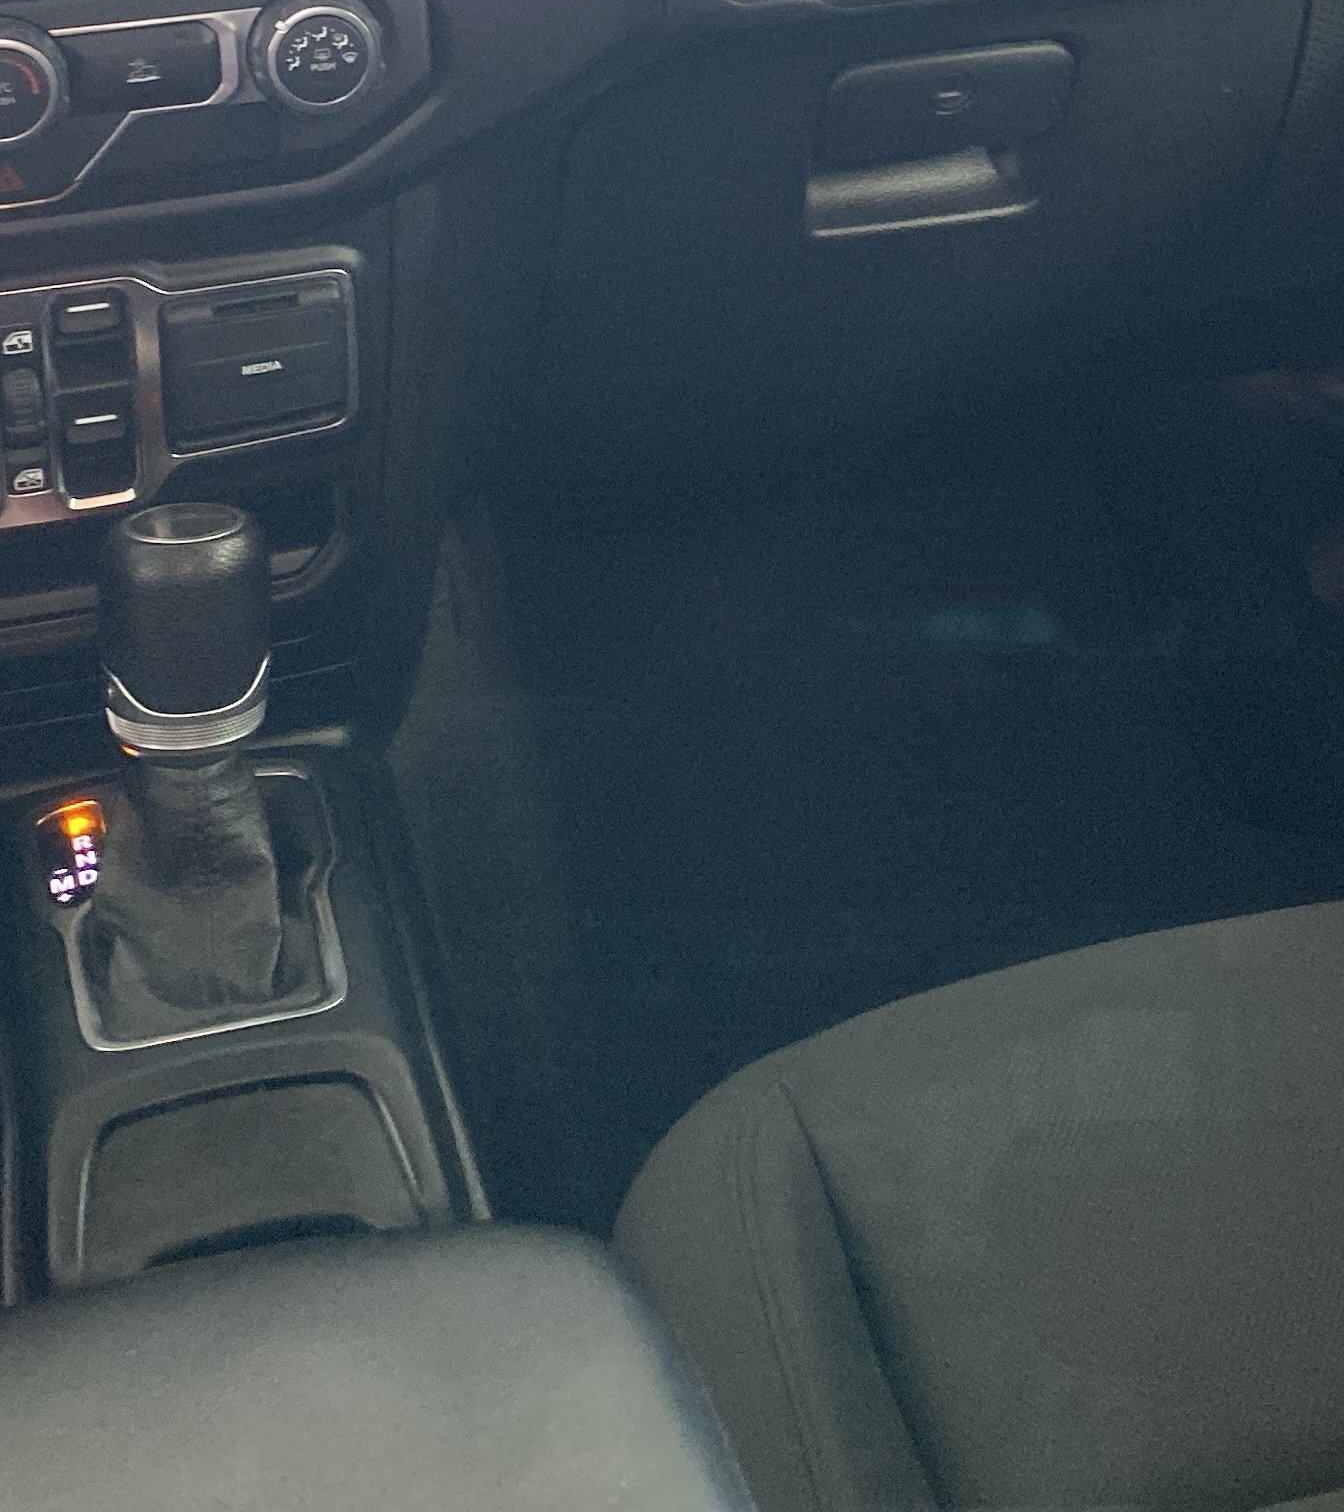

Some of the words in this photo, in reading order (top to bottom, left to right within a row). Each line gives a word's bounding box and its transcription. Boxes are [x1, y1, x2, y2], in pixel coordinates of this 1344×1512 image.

[241, 360, 284, 377] MEDIA
[73, 835, 93, 851] R
[74, 850, 97, 869] N
[49, 874, 75, 894] M
[77, 869, 98, 886] D
